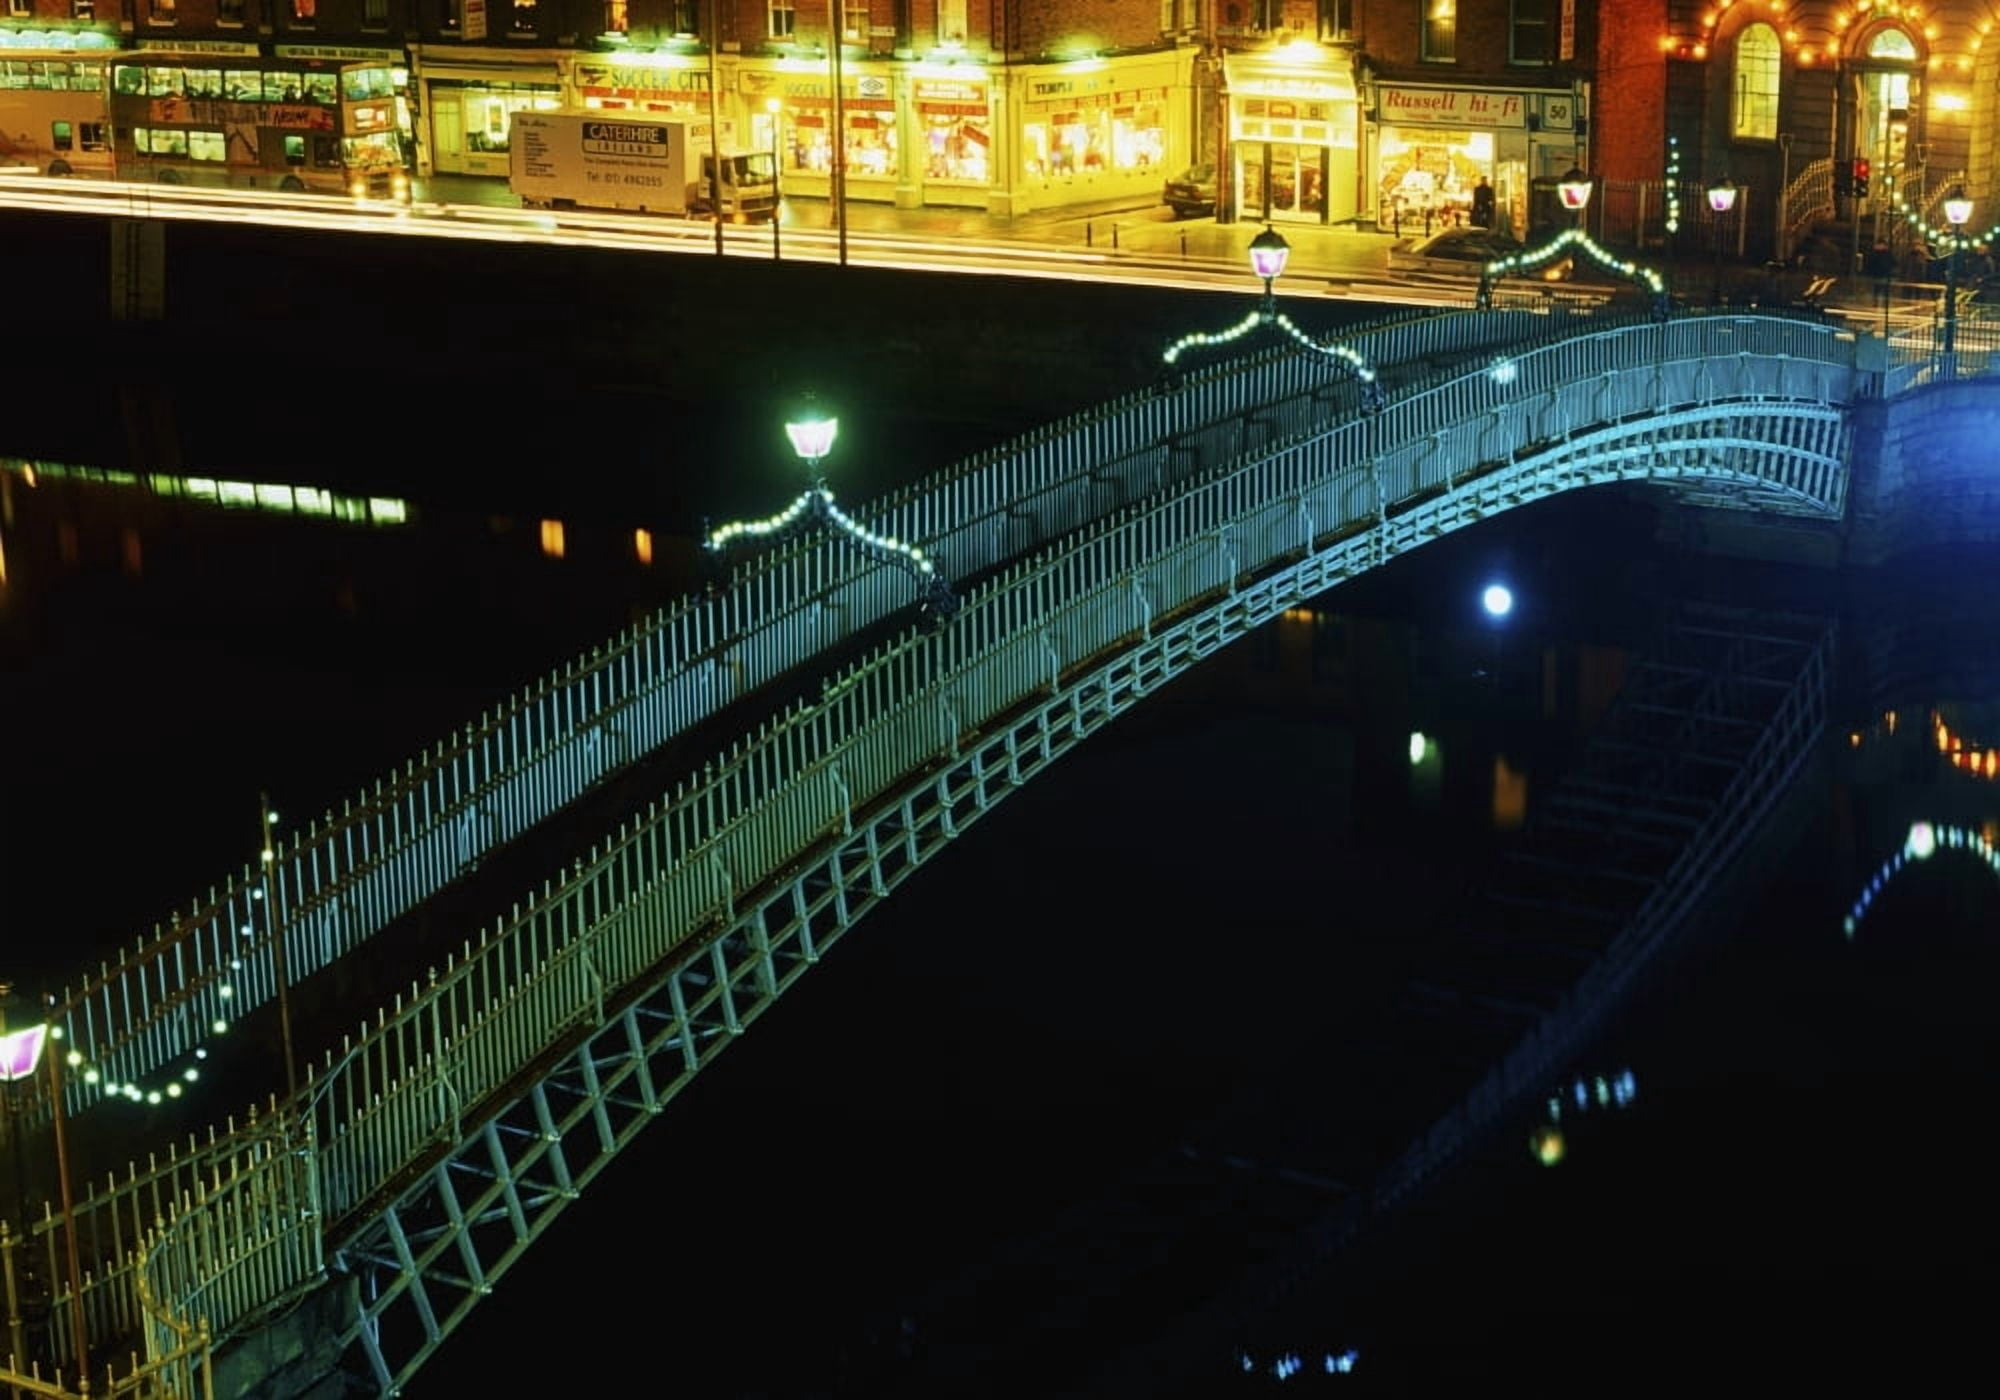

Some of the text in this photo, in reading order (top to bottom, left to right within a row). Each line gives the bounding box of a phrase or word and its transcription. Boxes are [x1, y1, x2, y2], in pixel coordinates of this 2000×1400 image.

[1386, 90, 1456, 111] Russell
[1550, 105, 1567, 120] 50
[590, 125, 660, 143] CATERHIRE
